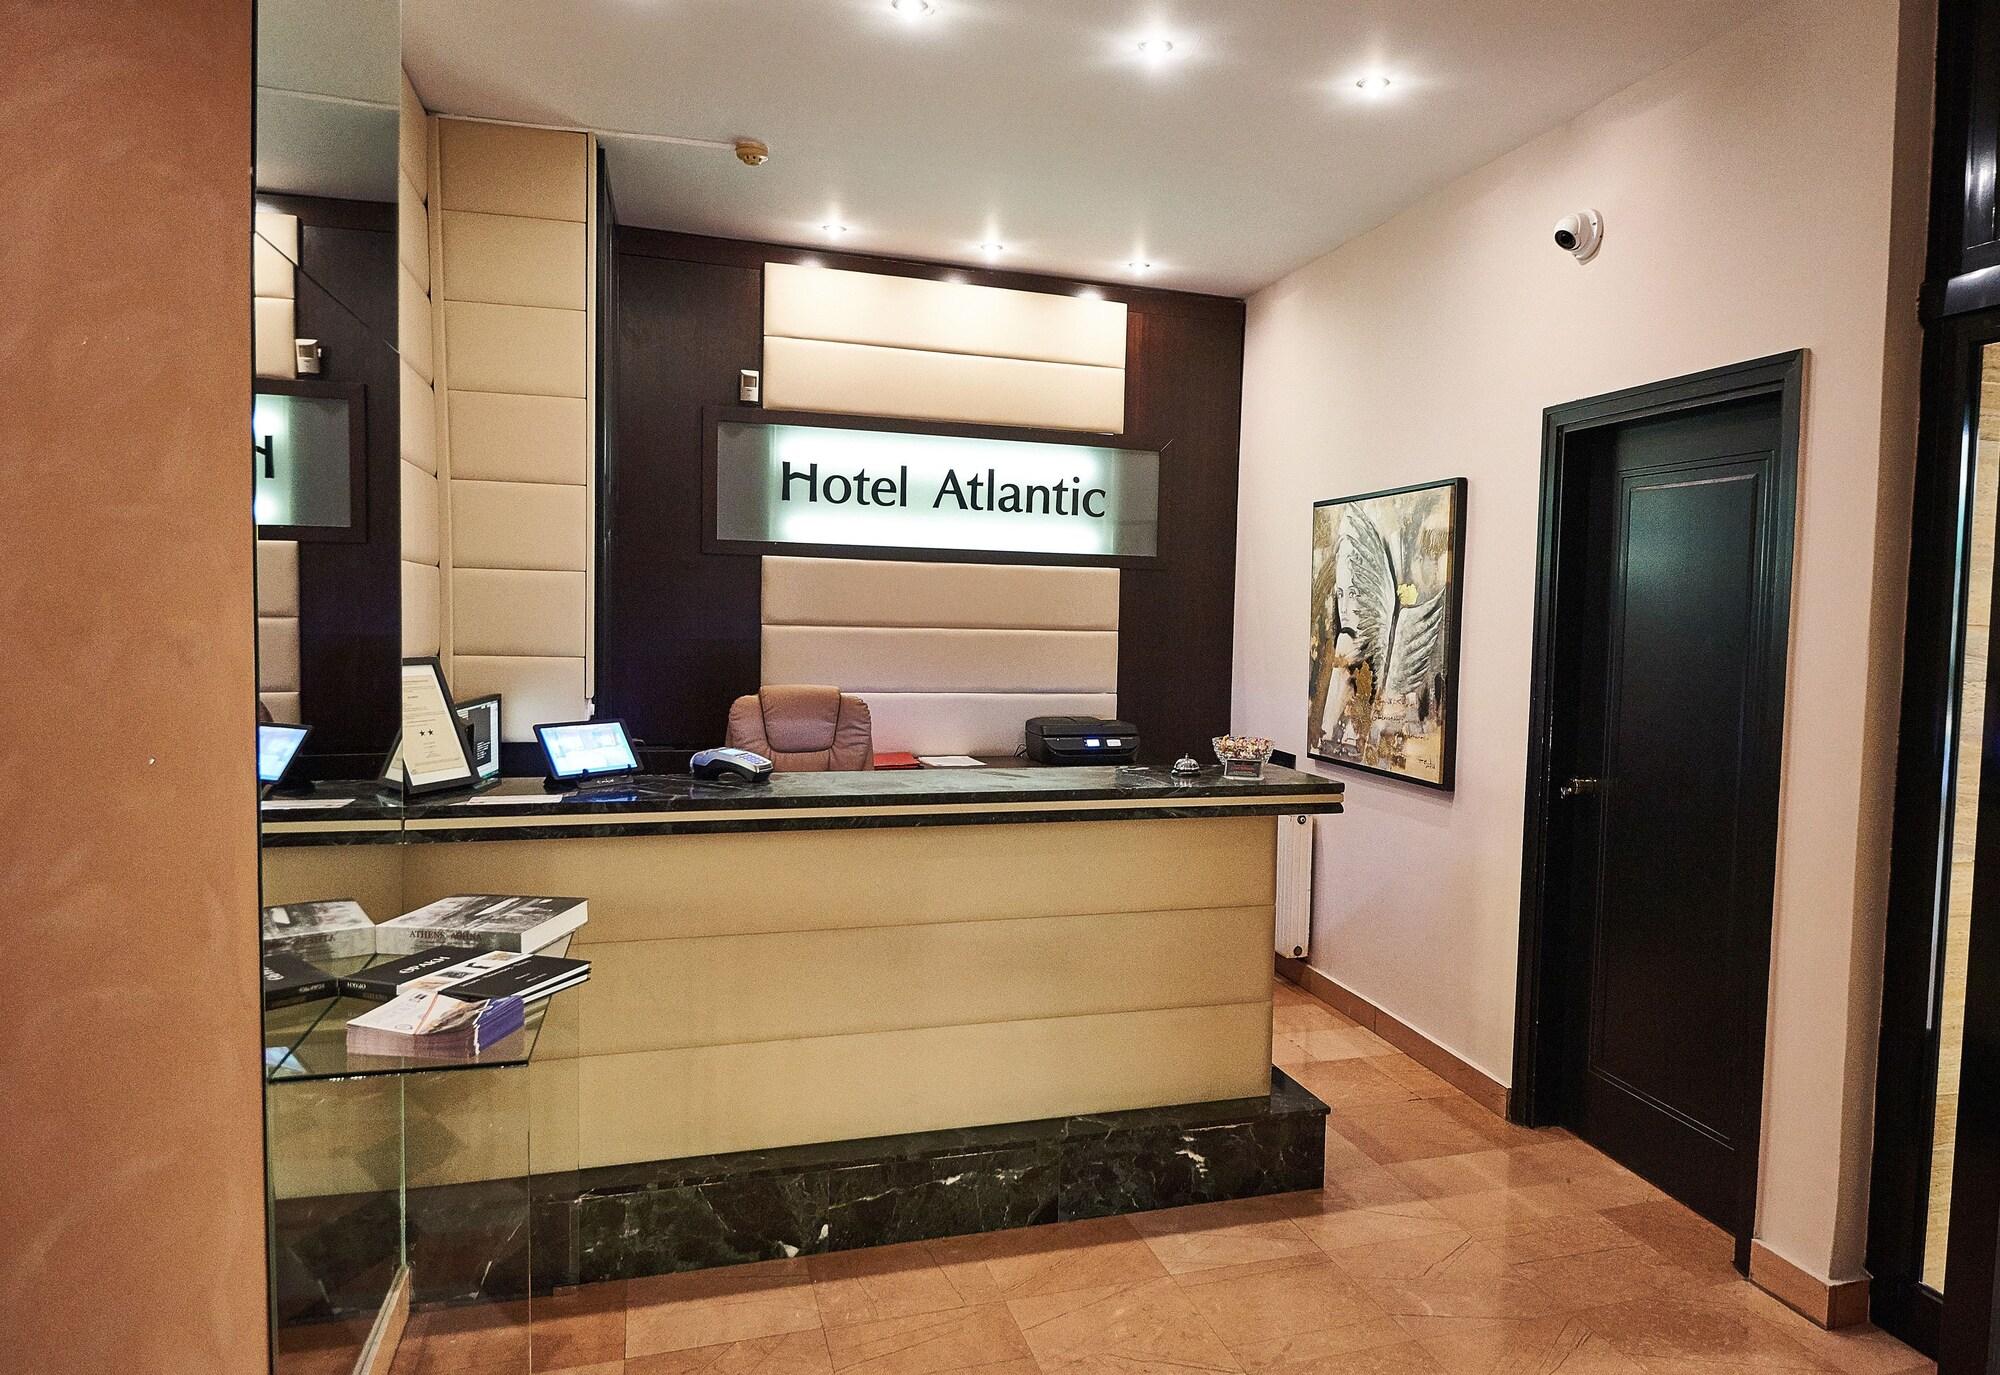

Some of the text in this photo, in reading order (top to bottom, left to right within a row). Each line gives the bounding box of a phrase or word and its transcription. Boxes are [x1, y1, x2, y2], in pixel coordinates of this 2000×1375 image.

[781, 461, 1106, 518] Hotel Atlantic
[408, 930, 447, 940] ATHENS
